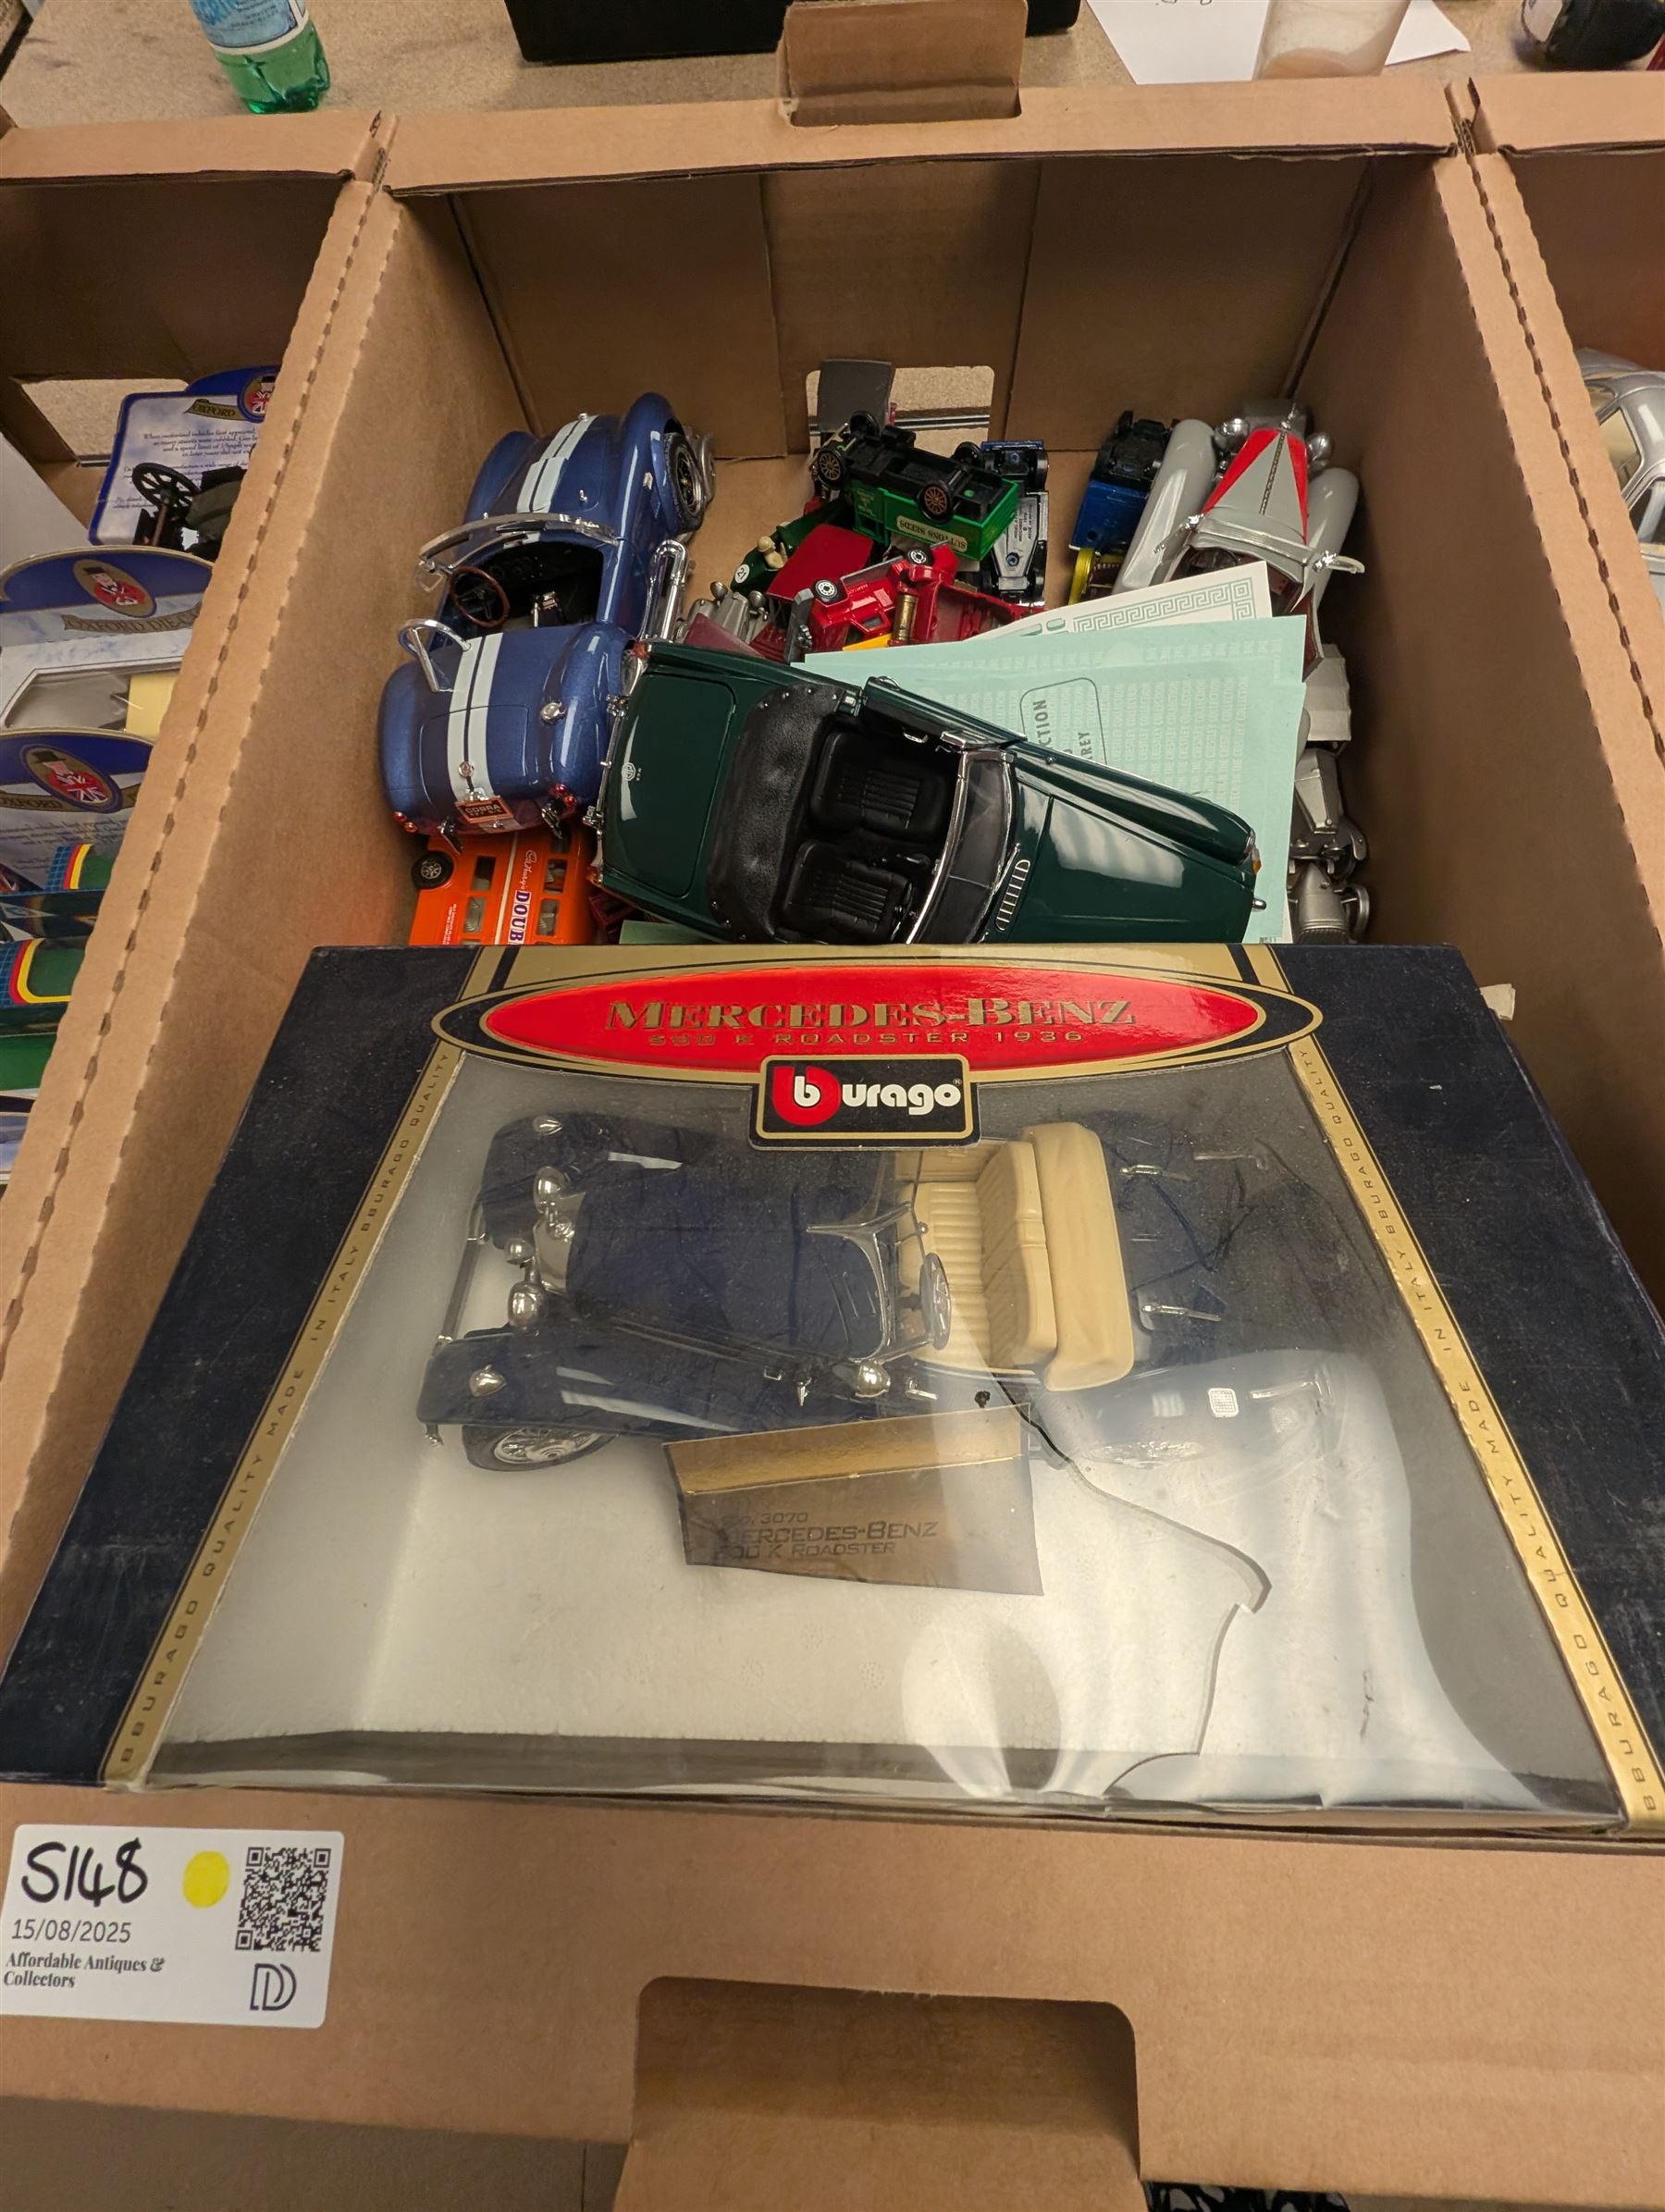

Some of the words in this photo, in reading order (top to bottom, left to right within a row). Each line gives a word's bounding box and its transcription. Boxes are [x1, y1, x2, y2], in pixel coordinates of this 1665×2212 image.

[68, 619, 145, 632] OXFORD
[465, 804, 500, 813] COBRA
[605, 997, 1136, 1030] MERCEDES-BENZ
[775, 1031, 969, 1045] ROADSTER
[993, 1030, 1084, 1043] 1936
[1298, 1048, 1342, 1125] QUALITY
[1396, 1248, 1433, 1312] ITALY
[202, 1453, 264, 1578] QUALITY
[266, 1367, 304, 1437] MADE
[310, 1318, 327, 1341] IN
[327, 1245, 360, 1304] ITALY
[409, 1053, 450, 1128] QUALITY
[1434, 1328, 1452, 1352] IN
[1459, 1379, 1500, 1454] MADE
[760, 1512, 809, 1526] 3070
[791, 1541, 896, 1558] ROADSTER
[1504, 1475, 1570, 1609] QUALITY
[21, 1837, 149, 1908] S148
[11, 1918, 132, 1944] 15/08/2025
[6, 1952, 82, 1970] Affordable
[86, 1955, 148, 1974] Antiques
[150, 1957, 166, 1972] &
[3, 1971, 76, 1988] Collectors
